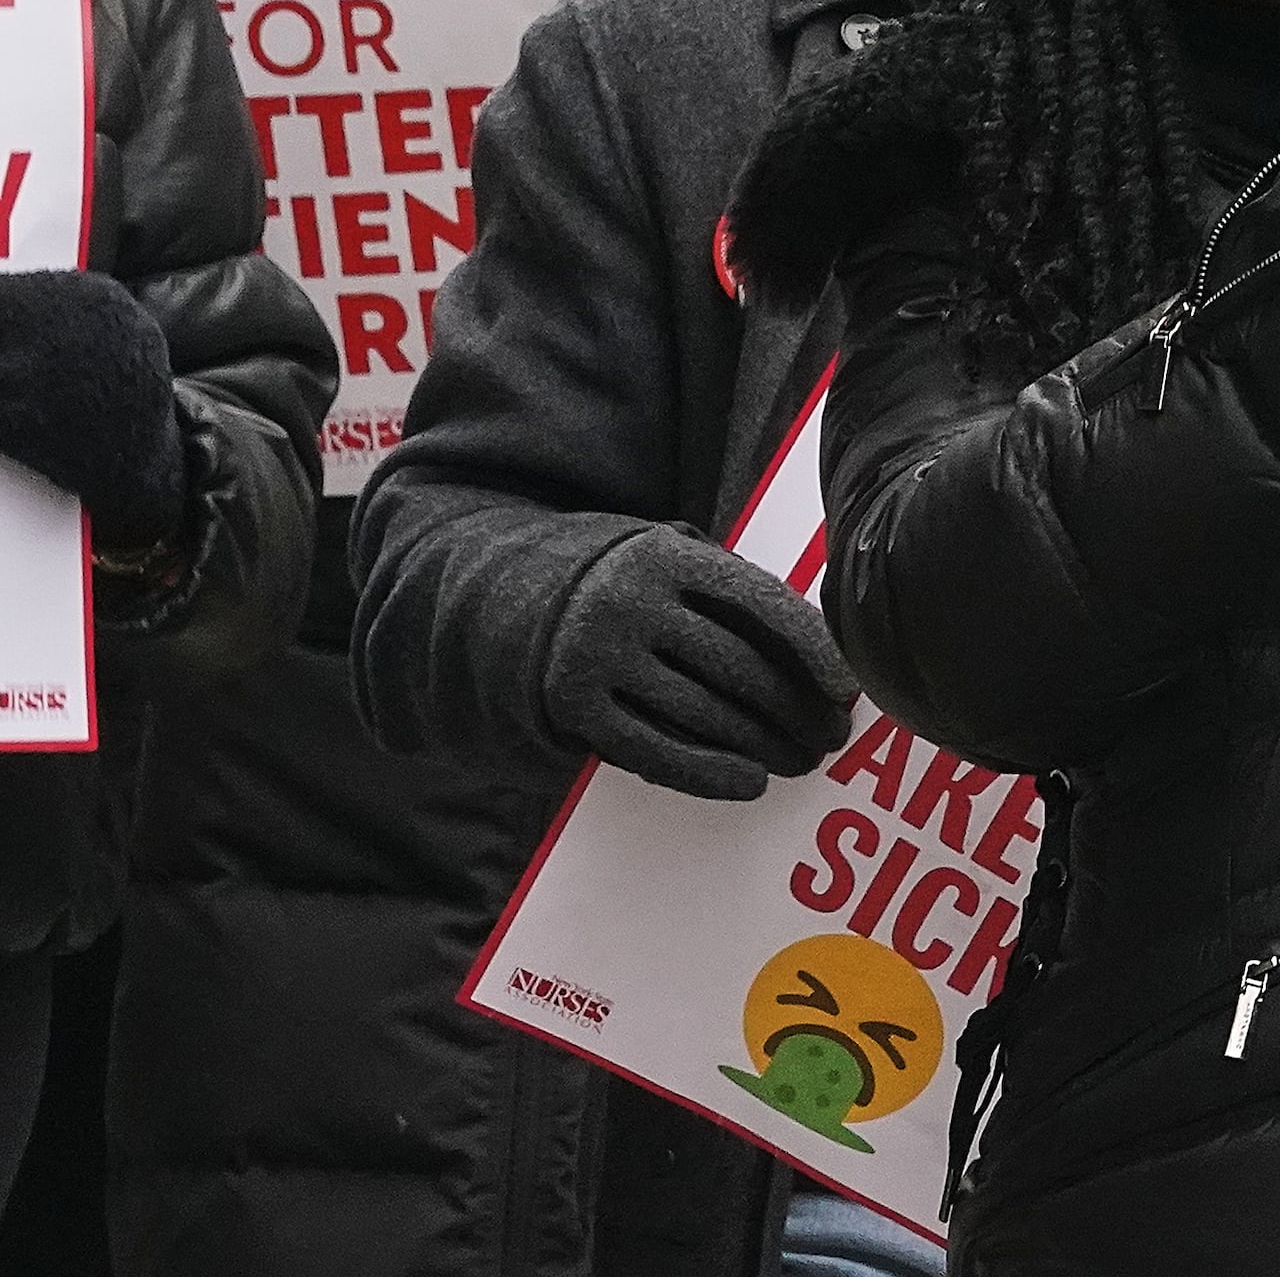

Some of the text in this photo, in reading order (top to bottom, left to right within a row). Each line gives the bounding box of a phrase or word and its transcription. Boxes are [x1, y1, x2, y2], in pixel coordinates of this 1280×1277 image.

[825, 714, 1042, 885] AKE
[789, 807, 1021, 1003] SICK
[508, 967, 612, 1024] NURSES
